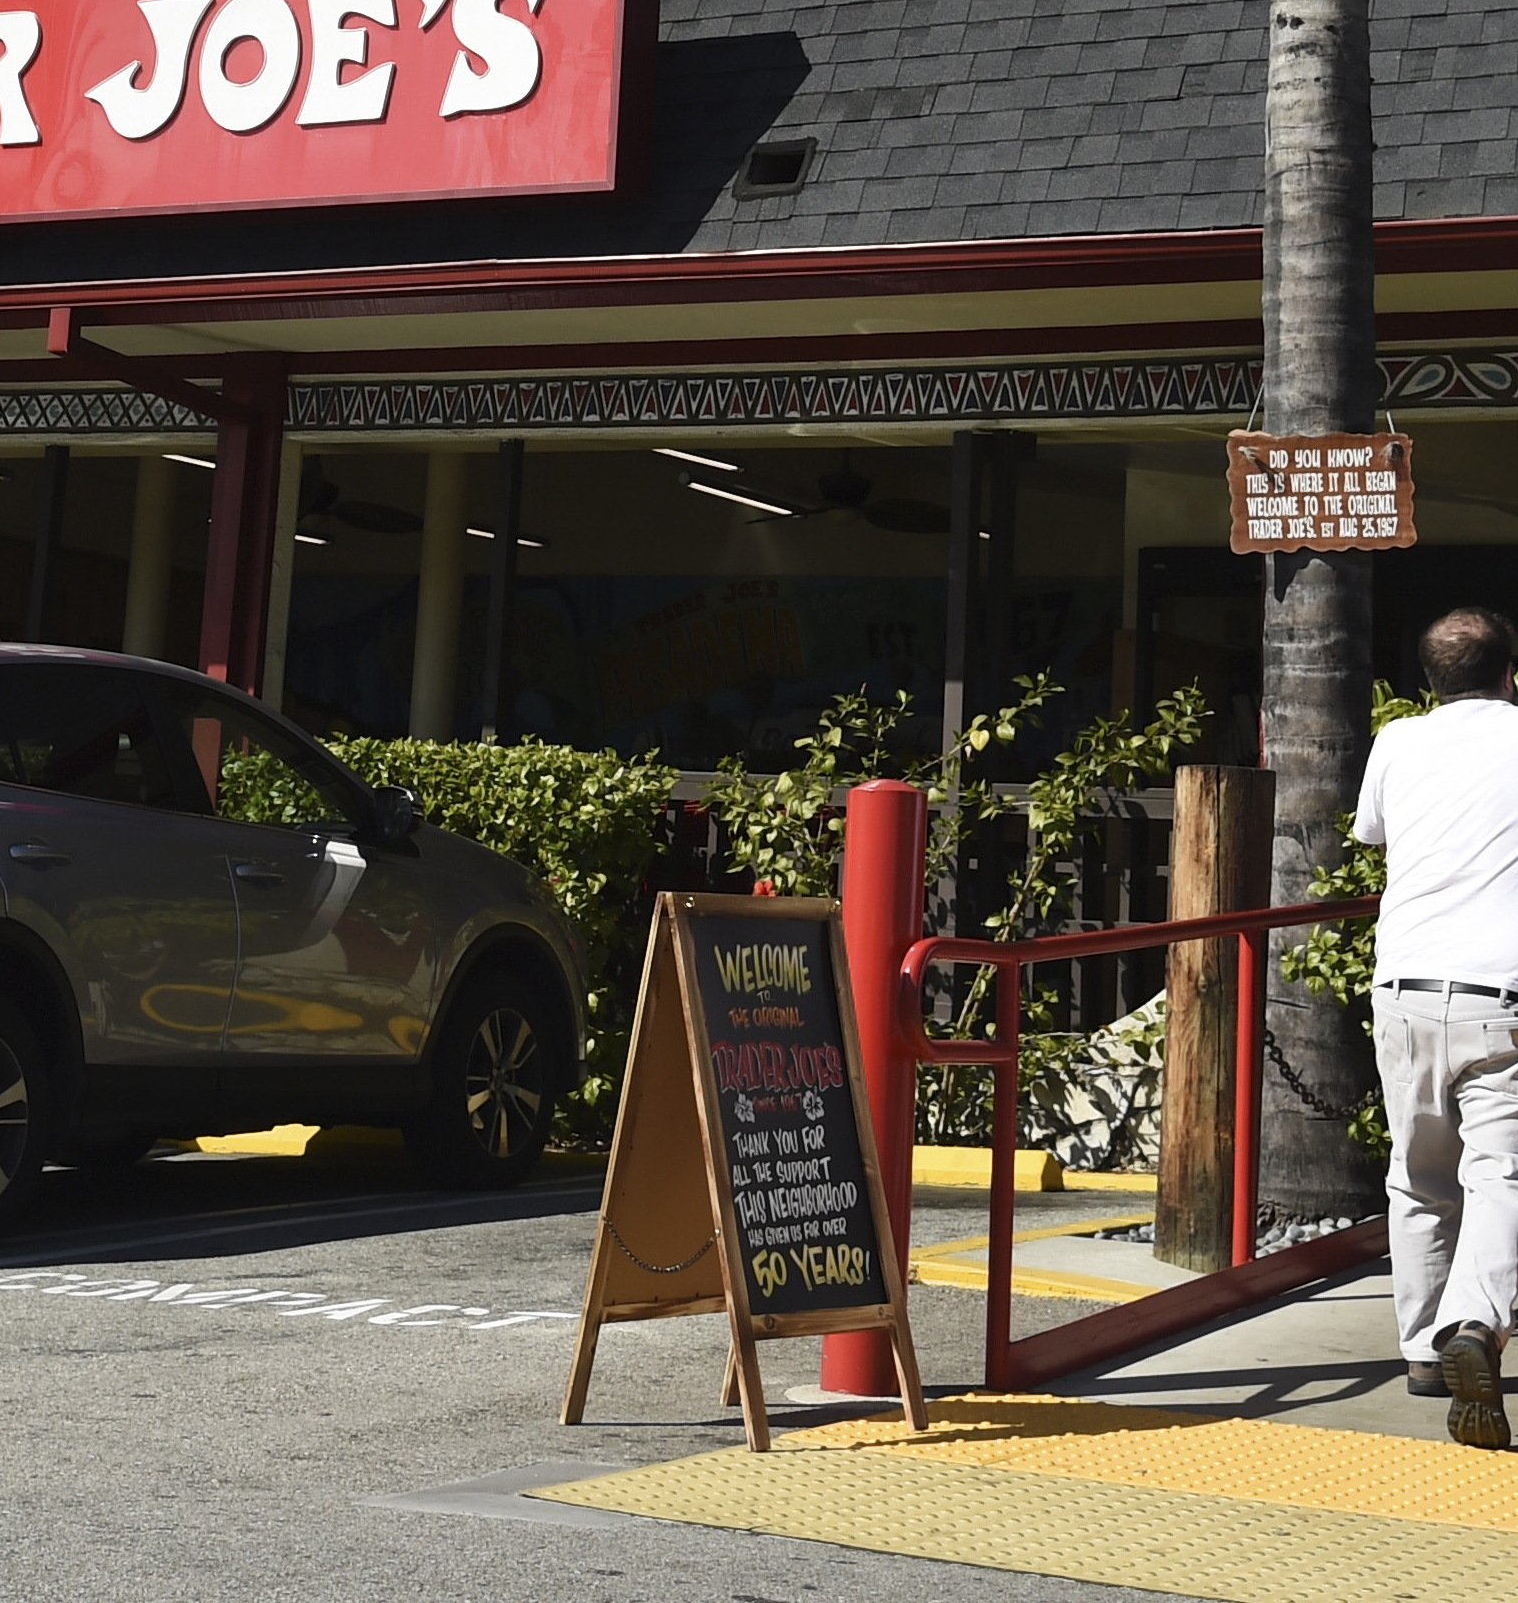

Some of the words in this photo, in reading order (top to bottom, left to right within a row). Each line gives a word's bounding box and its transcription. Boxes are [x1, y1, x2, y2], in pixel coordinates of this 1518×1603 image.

[1269, 449, 1289, 469] DID
[1294, 449, 1321, 469] YOU
[1327, 446, 1374, 469] KNOW?
[1245, 472, 1269, 495] THIS
[1273, 472, 1285, 494] IS
[1289, 472, 1324, 493] WHERE
[1328, 472, 1340, 493] IT
[1343, 471, 1361, 493] ALL
[1365, 470, 1397, 493] BEGAN
[1245, 496, 1299, 518] WELCOME
[1303, 495, 1319, 516] TO
[1322, 495, 1344, 516] THE
[1347, 494, 1398, 516] ORIGINAL
[1247, 518, 1284, 540] TRADER
[1286, 515, 1318, 539] JOE'S.
[1320, 522, 1335, 538] EST
[1338, 516, 1358, 538] AUG
[713, 943, 812, 996] WELCOME
[728, 1007, 751, 1029] THE
[752, 1006, 806, 1030] ORIGINAL
[711, 1039, 789, 1094] TRADER
[787, 1042, 845, 1093] JOE'S
[732, 1131, 771, 1159] THANK
[772, 1127, 799, 1156] YOU
[801, 1124, 826, 1154] FOR
[732, 1164, 752, 1188] ALL
[752, 1161, 774, 1184] THE
[776, 1156, 832, 1184] SUPPORT
[734, 1190, 767, 1229] THIS
[767, 1181, 858, 1223] NEIGHBORHOOD
[747, 1229, 765, 1248] HAS
[764, 1225, 790, 1246] GIVEN
[788, 1222, 803, 1243] US
[803, 1220, 821, 1240] FOR
[822, 1217, 848, 1238] OVER
[751, 1248, 788, 1298] 50
[789, 1242, 872, 1293] YEARS!
